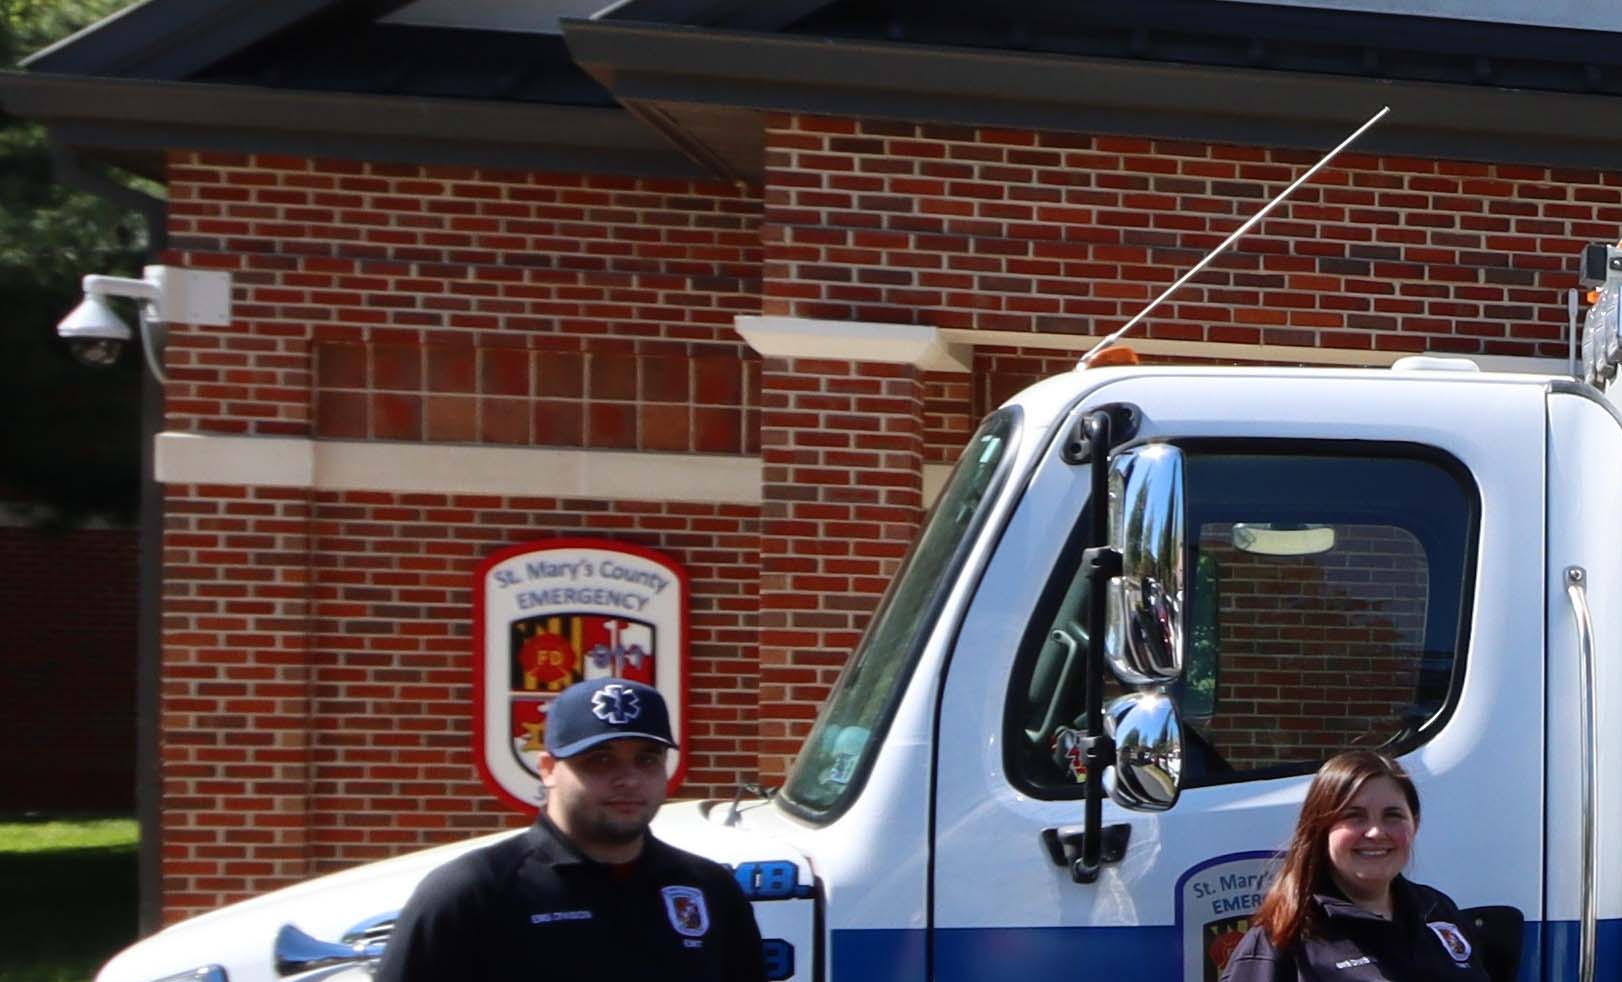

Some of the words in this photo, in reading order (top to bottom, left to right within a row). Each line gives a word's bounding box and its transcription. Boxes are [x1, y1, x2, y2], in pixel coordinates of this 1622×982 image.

[494, 569, 520, 588] St.
[525, 558, 593, 581] Mary's
[599, 560, 670, 595] County
[516, 587, 651, 611] EMERGENCY
[1193, 882, 1217, 899] St.
